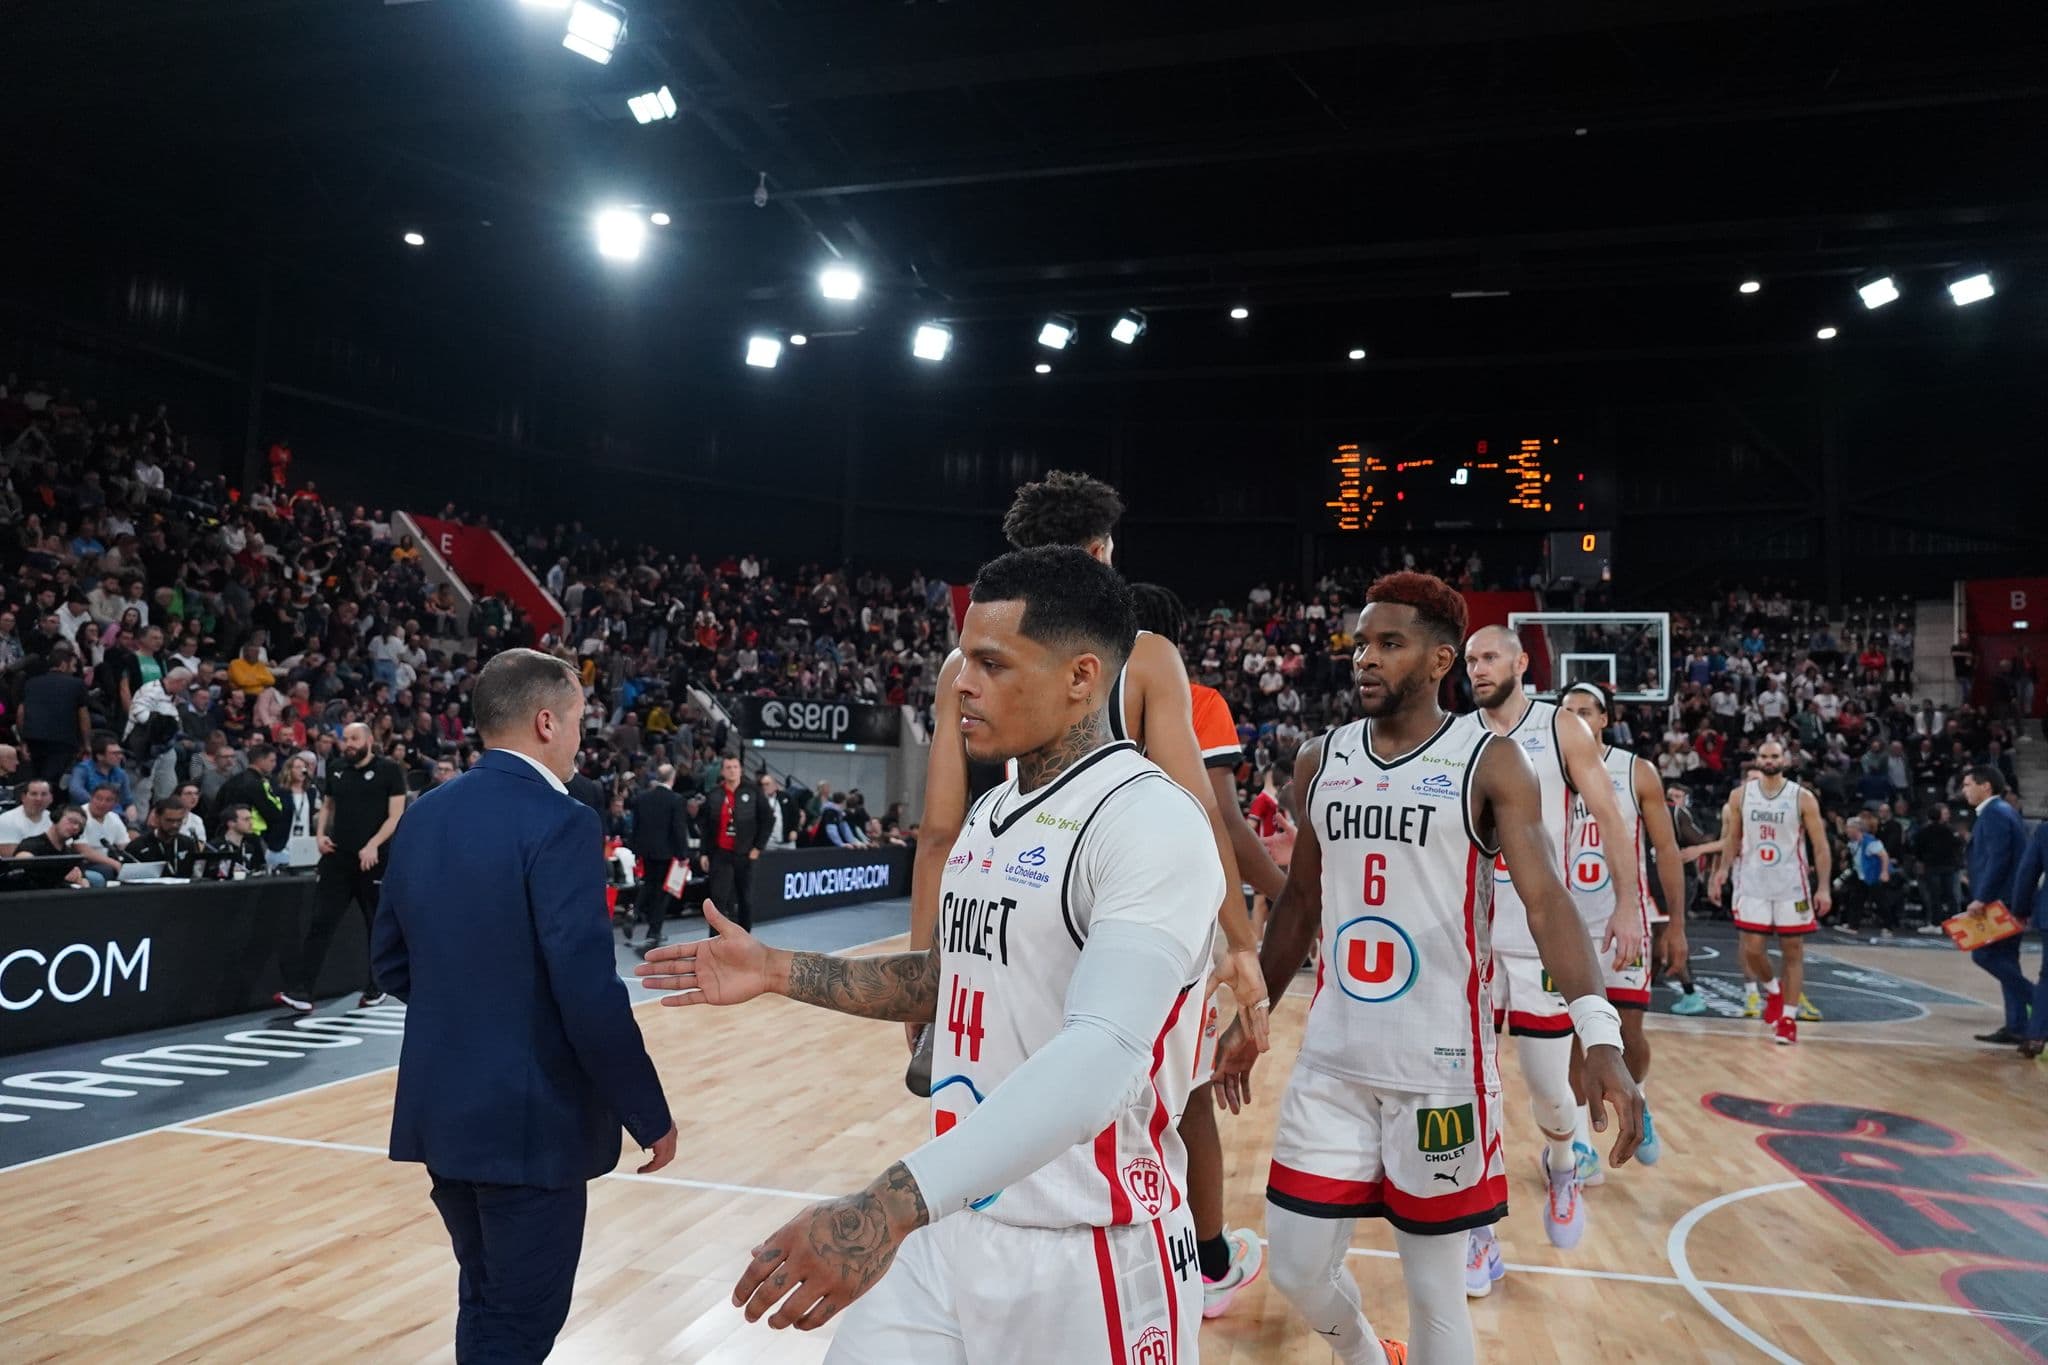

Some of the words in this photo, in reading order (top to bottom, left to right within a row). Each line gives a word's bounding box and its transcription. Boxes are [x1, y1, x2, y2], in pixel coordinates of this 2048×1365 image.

[440, 533, 453, 554] E
[1583, 534, 1595, 551] 0
[2010, 590, 2027, 610] B
[788, 702, 849, 740] serp
[1326, 801, 1436, 847] CHOLET
[1760, 824, 1776, 840] 34
[1005, 863, 1013, 873] Le
[1363, 853, 1387, 906] 6
[1578, 863, 1599, 883] U
[943, 892, 1017, 966] CHOLET
[1347, 938, 1394, 983] U
[948, 974, 985, 1062] 44
[1425, 1147, 1466, 1163] CHOLET
[1129, 1170, 1159, 1201] CB
[1168, 1226, 1198, 1282] 44
